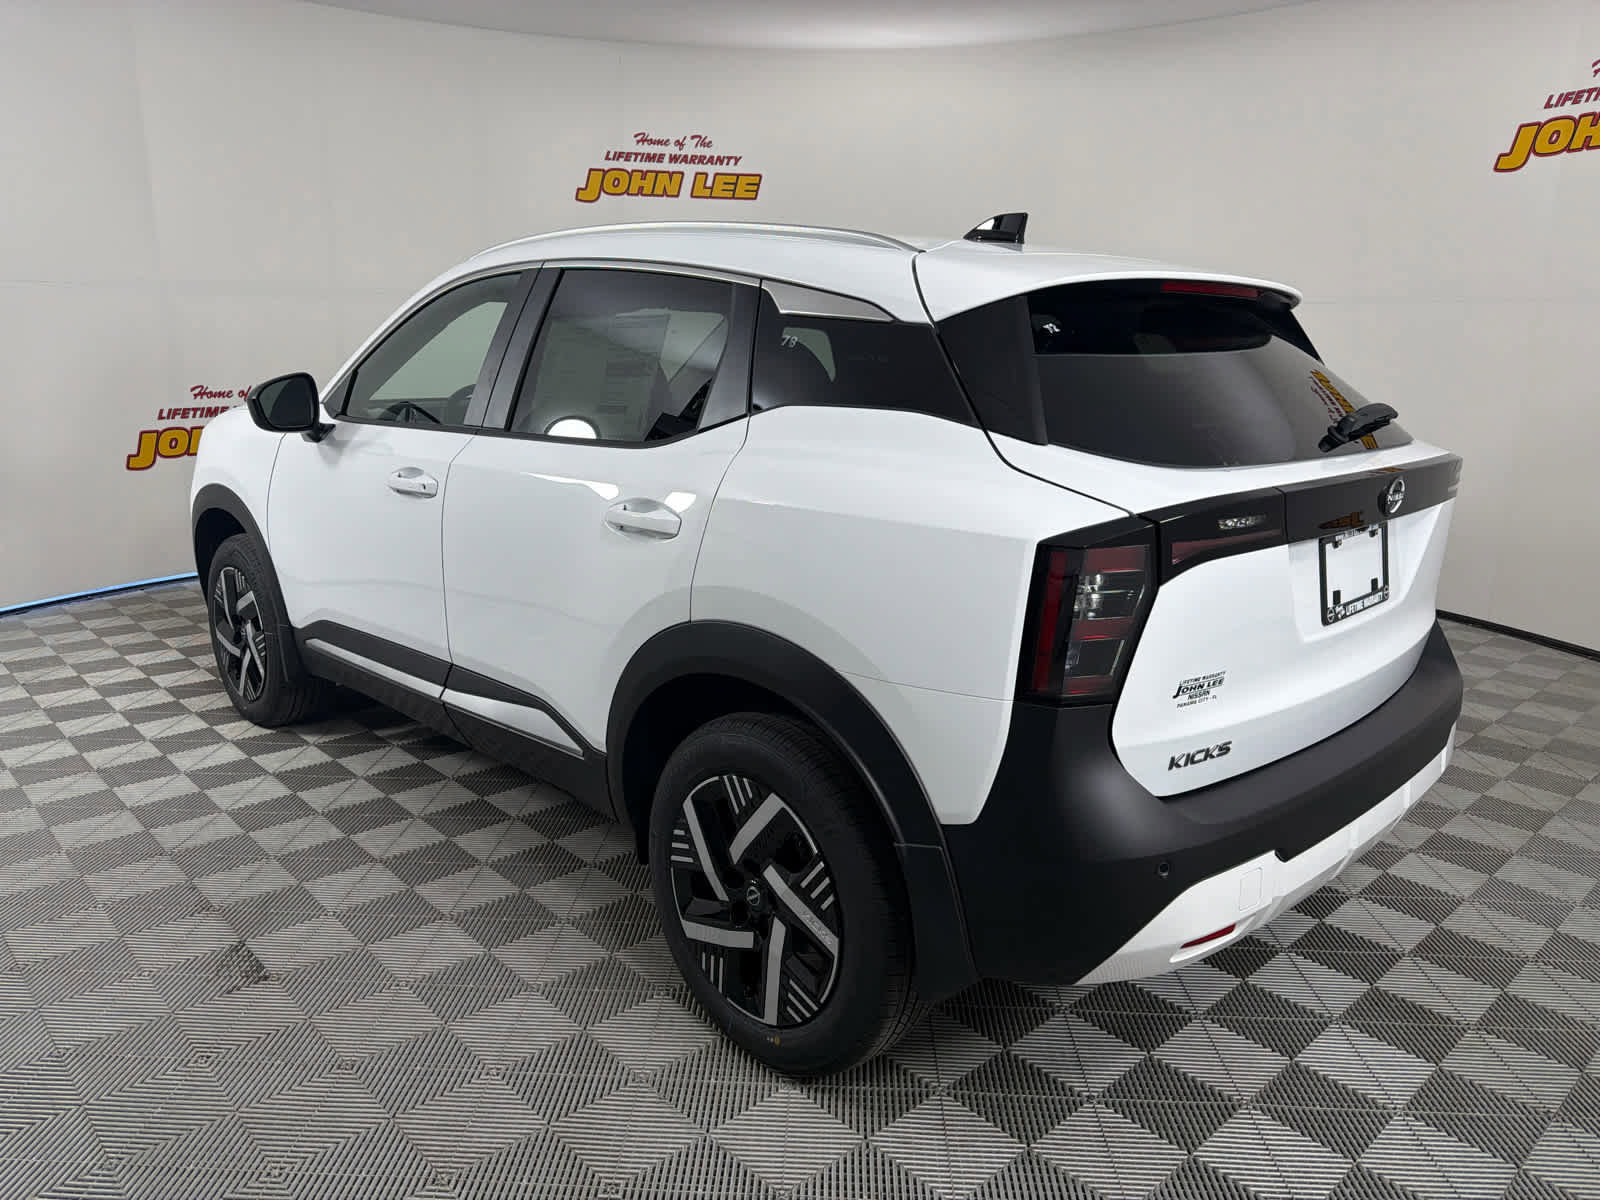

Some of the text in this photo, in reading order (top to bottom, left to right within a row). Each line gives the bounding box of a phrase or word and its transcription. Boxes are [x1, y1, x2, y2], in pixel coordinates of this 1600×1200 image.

[633, 132, 713, 150] Home of The
[604, 150, 742, 166] LIFETIME WARRANTY
[575, 168, 762, 203] JOHN LEE
[190, 385, 251, 401] Home of
[1172, 677, 1224, 699] JOHN LEE
[1168, 740, 1232, 771] KICKS
